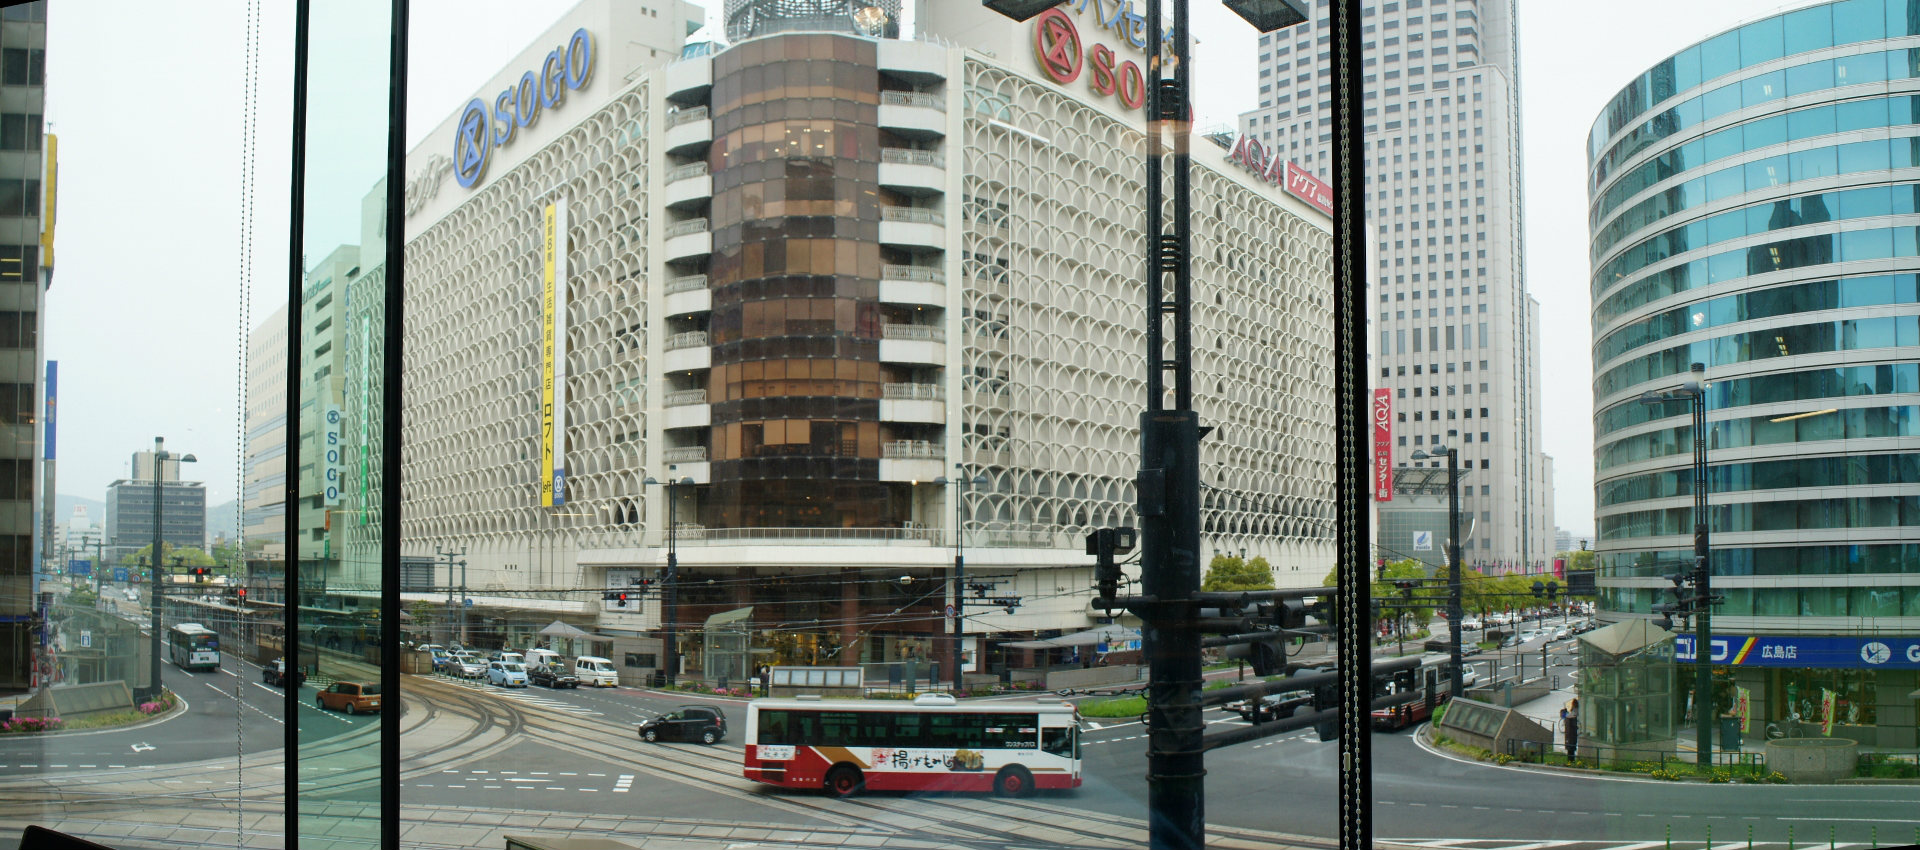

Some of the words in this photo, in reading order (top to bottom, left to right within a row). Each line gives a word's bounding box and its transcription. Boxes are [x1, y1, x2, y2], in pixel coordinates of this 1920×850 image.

[495, 28, 596, 148] SOGO
[1289, 167, 1318, 199] アクア
[544, 403, 552, 460] ロフト
[327, 431, 338, 500] SOGO
[1378, 456, 1389, 498] センター街
[1761, 645, 1797, 659] 広島店
[891, 749, 953, 770] 揚げもみじ
